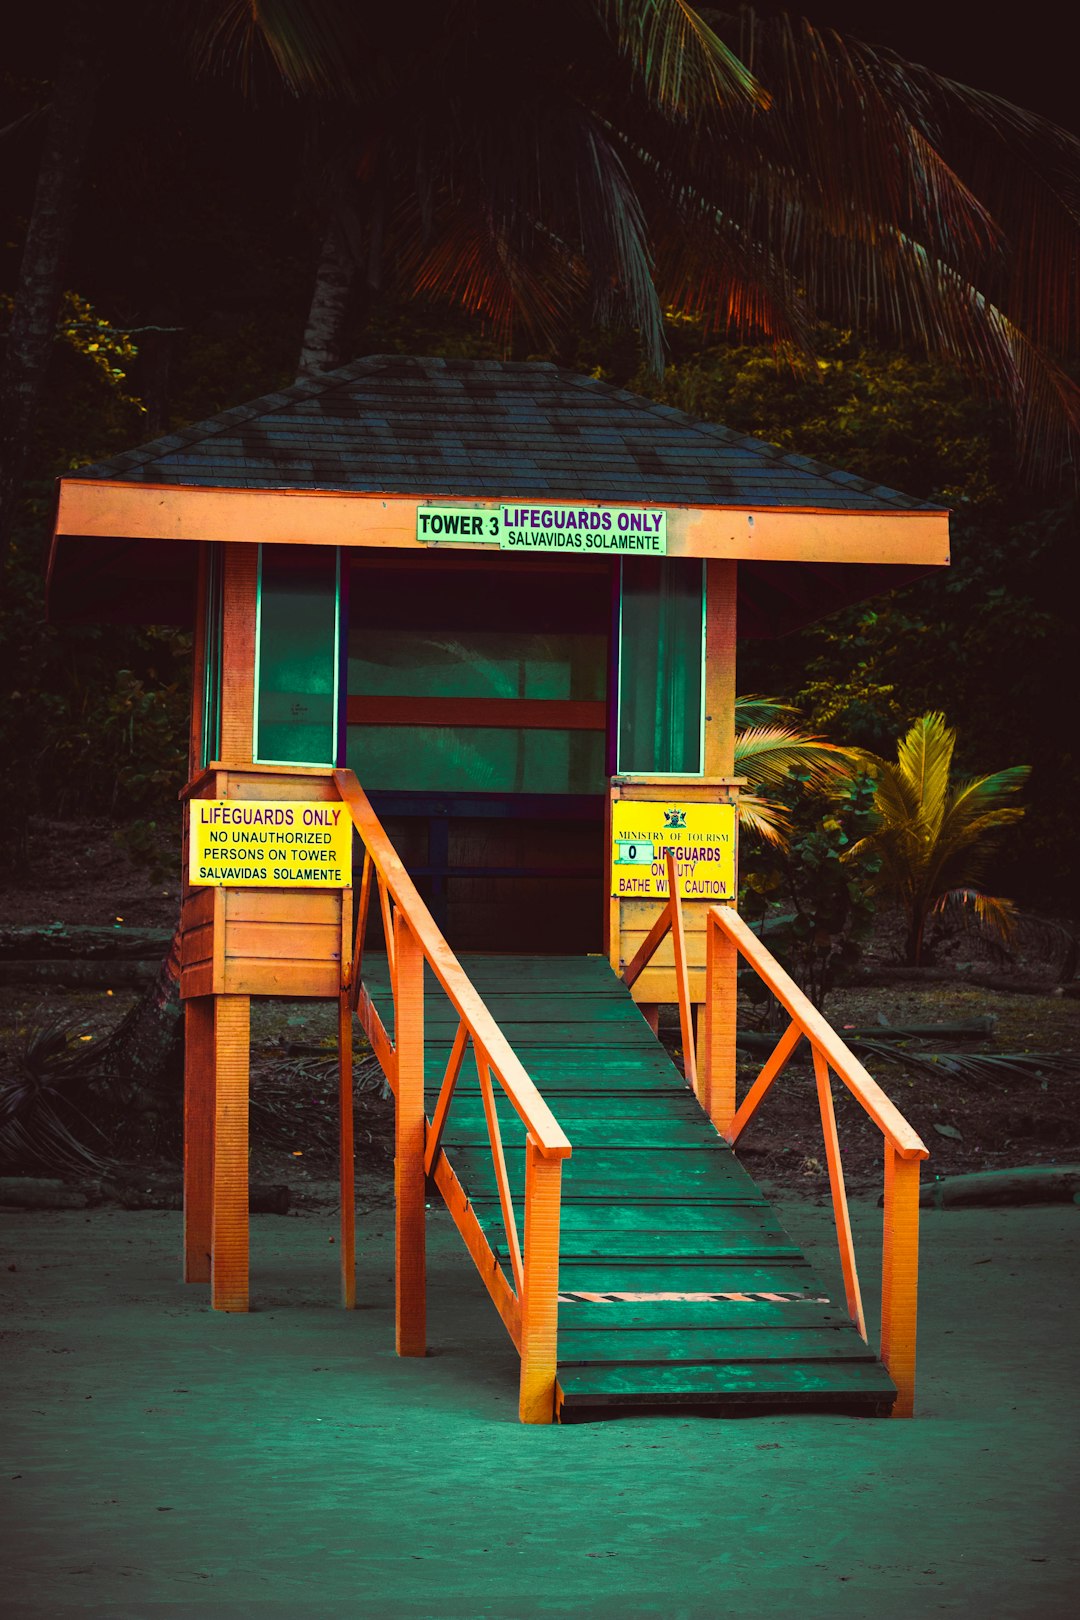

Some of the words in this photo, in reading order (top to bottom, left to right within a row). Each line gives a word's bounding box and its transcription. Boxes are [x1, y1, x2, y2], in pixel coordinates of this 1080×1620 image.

[420, 514, 483, 536] TOWER
[489, 516, 499, 536] 3
[504, 508, 612, 530] LIFEGUARDS
[618, 512, 663, 532] ONLY
[508, 531, 582, 548] SALVAVIDAS
[586, 534, 660, 550] SOLAMENTE
[201, 808, 294, 825] LIFEGUARDS
[302, 809, 341, 826] ONLY
[210, 831, 228, 842] NO
[232, 832, 332, 844] UNAUTHORIZED
[619, 832, 664, 840] MINISTRY
[670, 832, 682, 841] OF
[688, 834, 729, 842] TOURISM
[204, 848, 264, 860] PERSONS
[268, 850, 286, 860] ON
[291, 850, 336, 862] TOWER
[200, 867, 266, 879] SALVAVIDAS
[274, 868, 342, 880] SOLAMENTE
[652, 863, 664, 876] ON
[620, 878, 650, 892] BATHE
[684, 880, 726, 894] CAUTION
